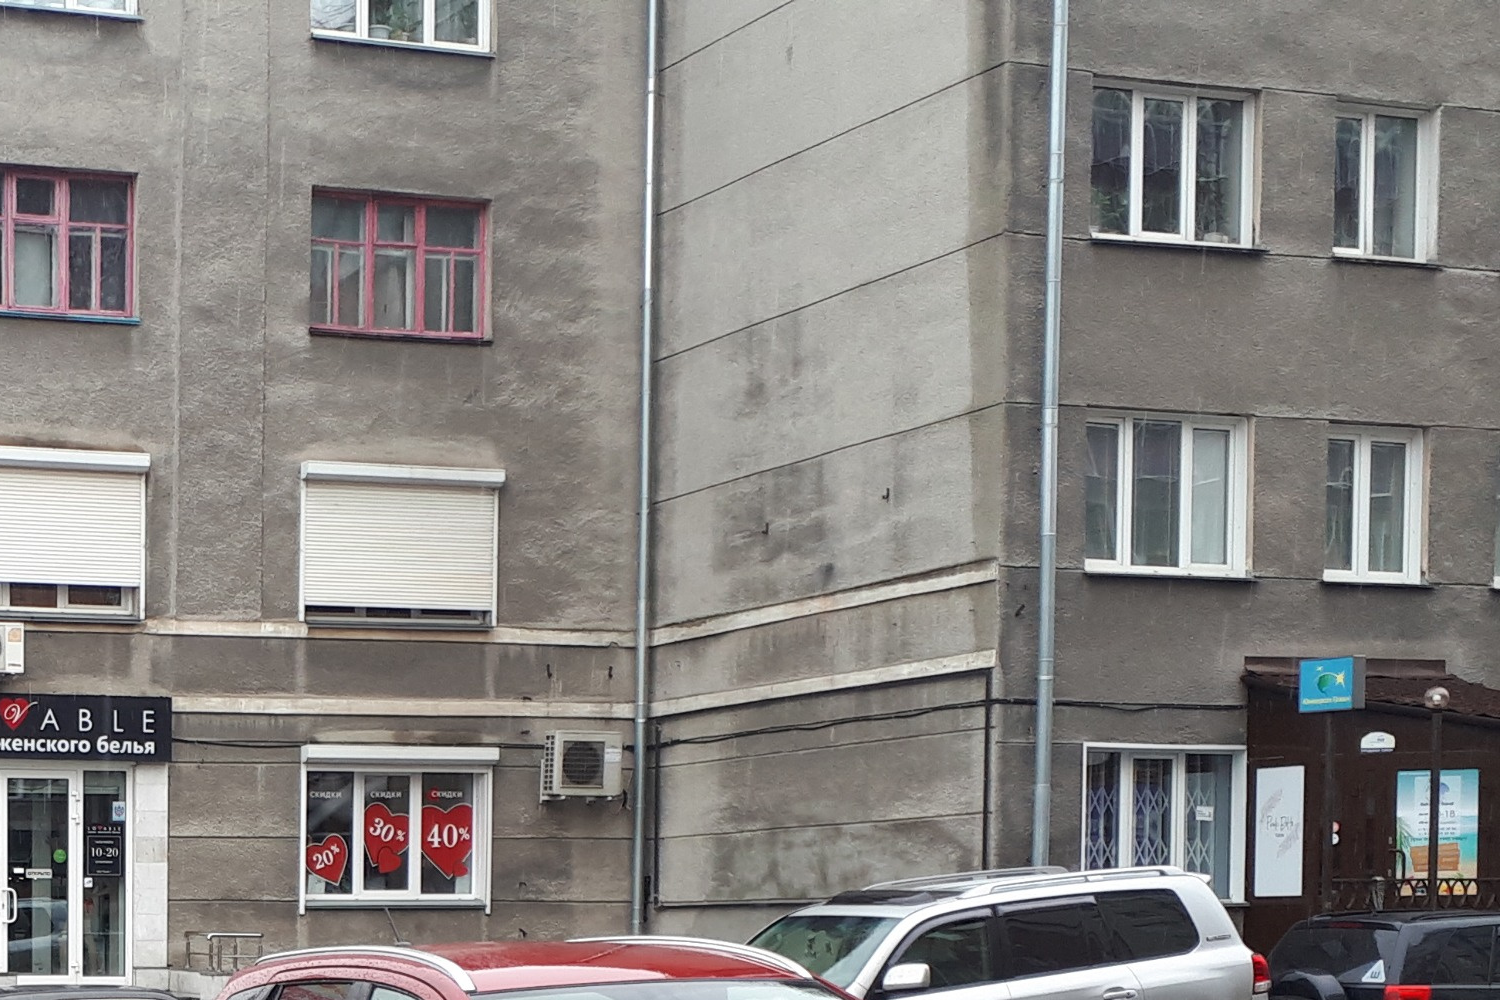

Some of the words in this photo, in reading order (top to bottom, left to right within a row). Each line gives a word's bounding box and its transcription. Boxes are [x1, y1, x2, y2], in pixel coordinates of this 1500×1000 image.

[96, 735, 156, 755] белья
[369, 817, 406, 842] 30%
[427, 824, 470, 848] 40%
[91, 847, 119, 857] 10-20
[312, 843, 340, 870] 20%
